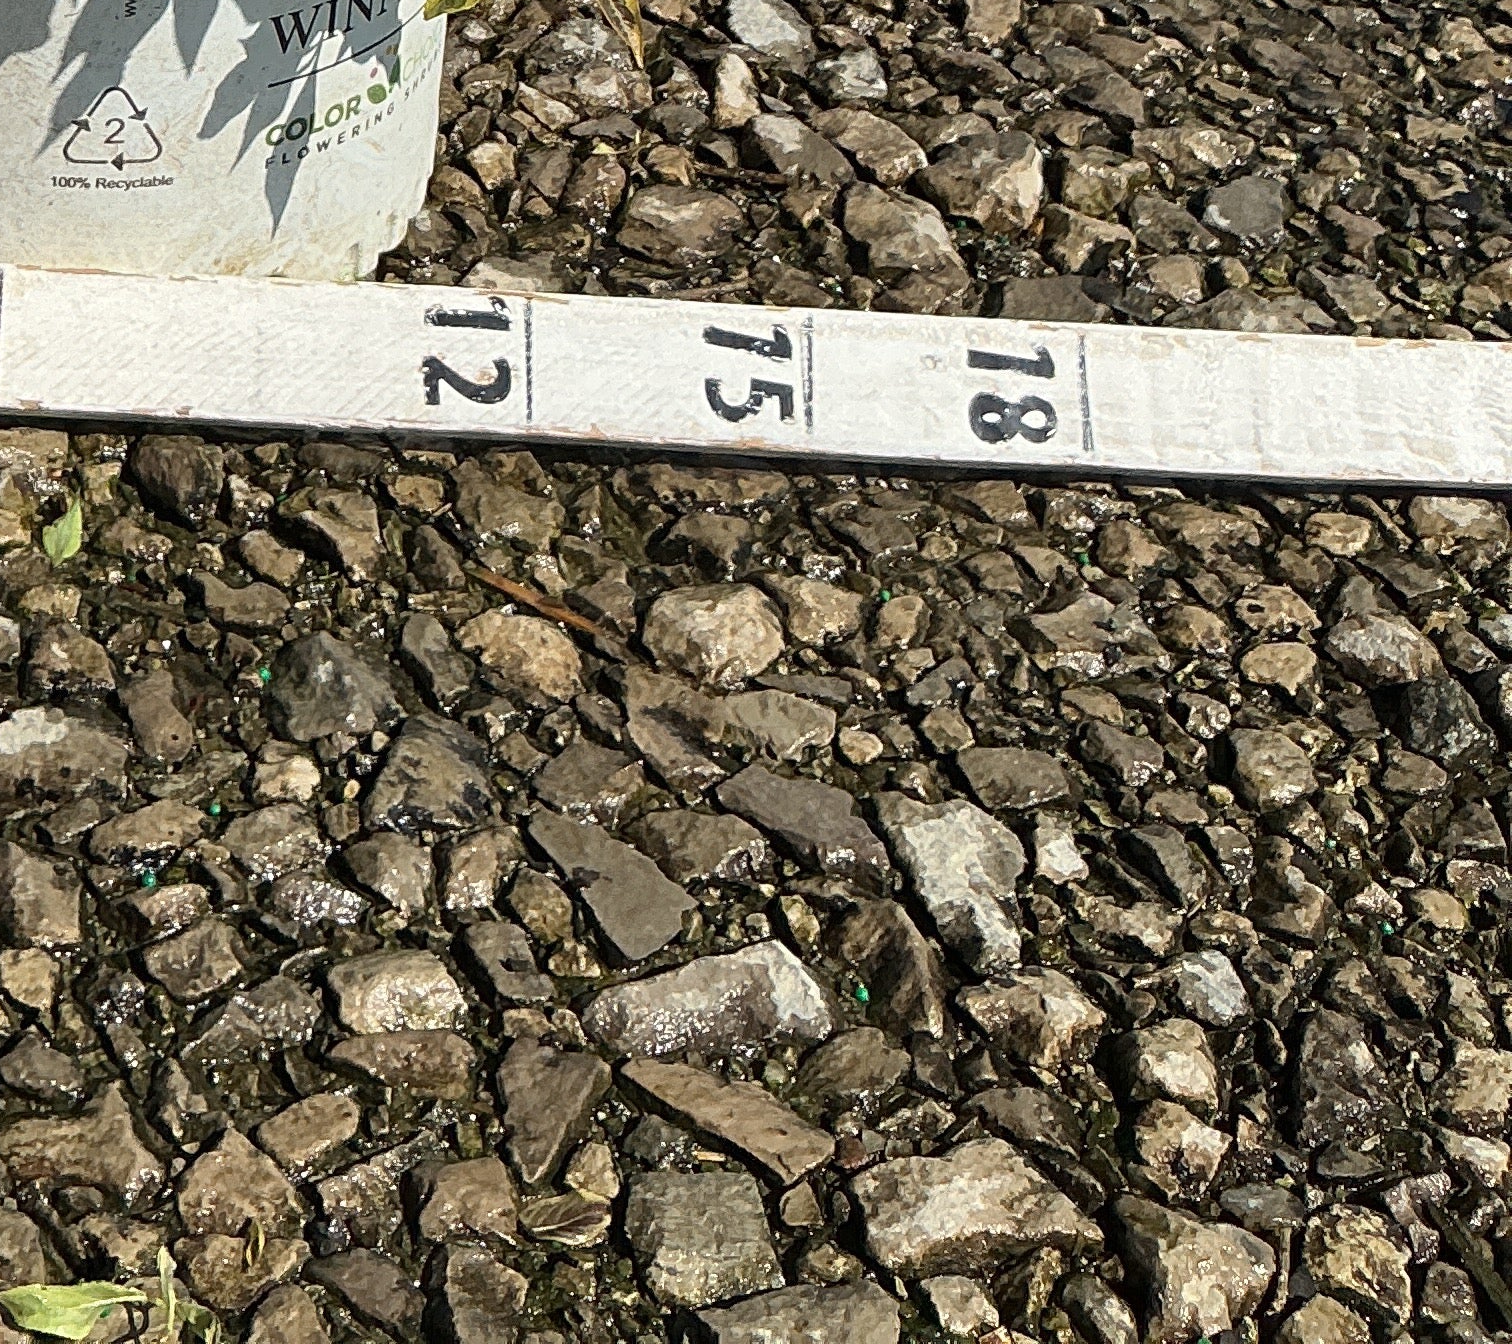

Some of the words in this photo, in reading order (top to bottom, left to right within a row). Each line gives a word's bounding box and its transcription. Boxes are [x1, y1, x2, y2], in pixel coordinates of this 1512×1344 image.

[103, 117, 126, 144] 2
[264, 101, 395, 170] FLOWERING
[265, 94, 362, 147] COLOR
[50, 175, 91, 190] 100%
[95, 174, 175, 192] Recyclable
[422, 296, 513, 406] 12
[703, 323, 795, 424] 15
[966, 345, 1057, 445] 18
